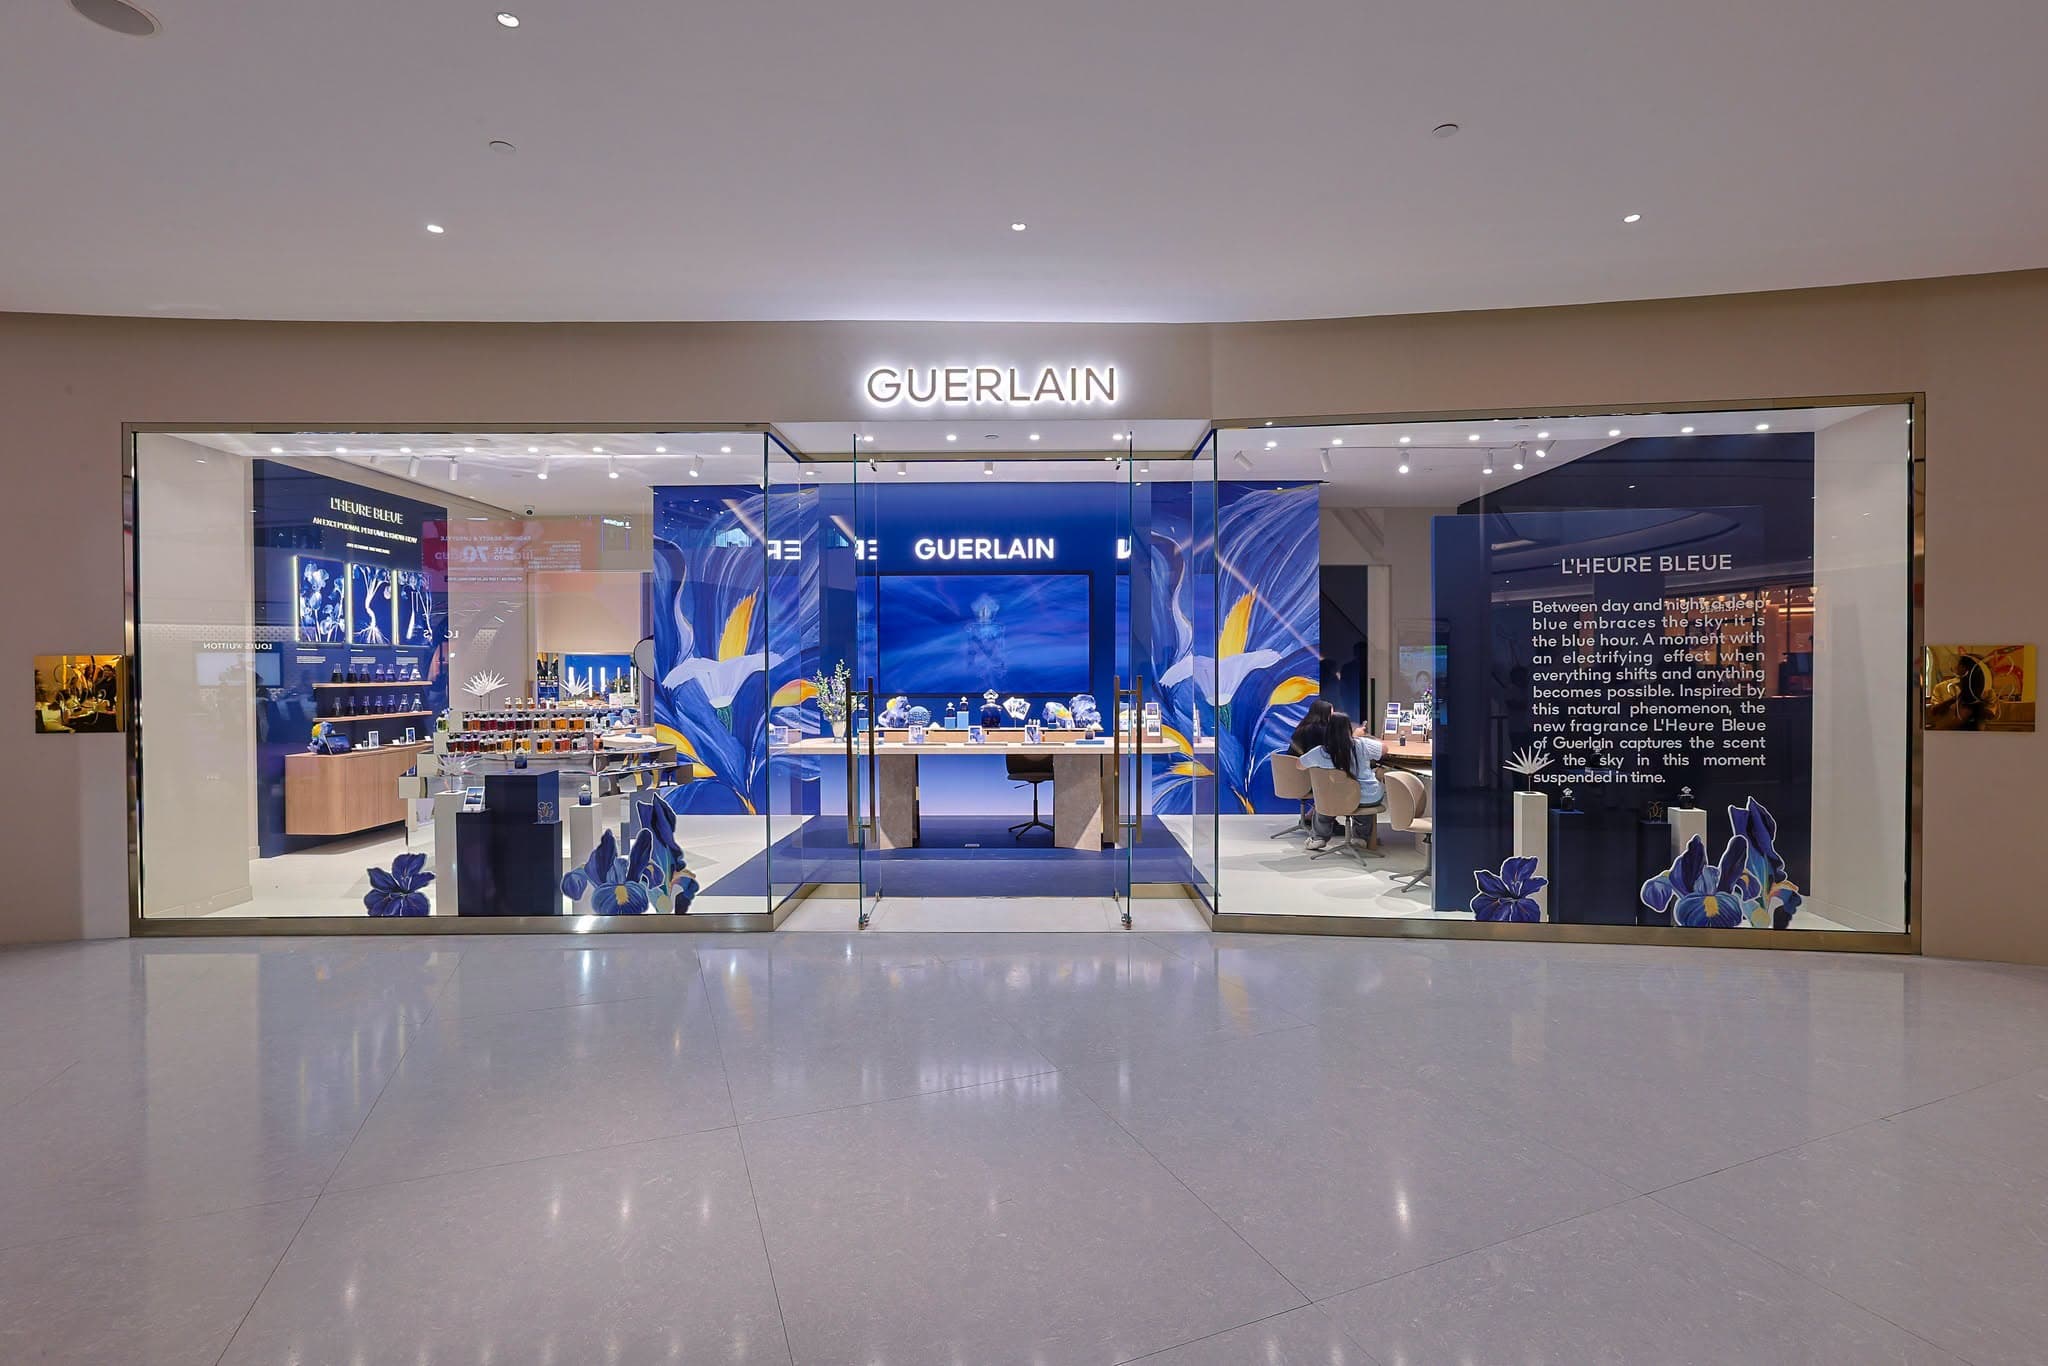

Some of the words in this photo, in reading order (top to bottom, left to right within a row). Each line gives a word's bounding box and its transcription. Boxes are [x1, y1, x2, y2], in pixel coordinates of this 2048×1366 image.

[867, 368, 1115, 402] GUERLAIN
[330, 497, 373, 518] L'HEURE
[373, 506, 404, 525] BLEUE
[915, 538, 1055, 560] GUERLAIN
[1561, 556, 1652, 574] L'HEURE
[1660, 554, 1733, 573] BLEUE
[1533, 600, 1598, 613] Between
[1602, 599, 1630, 615] day
[1633, 598, 1662, 612] and
[1725, 597, 1765, 612] deep
[1533, 618, 1568, 630] blue
[1573, 616, 1656, 630] embraces
[1661, 615, 1689, 628] the
[1734, 614, 1746, 626] it
[1752, 613, 1765, 626] is
[1532, 634, 1557, 647] the
[1562, 634, 1595, 647] blue
[1600, 633, 1639, 646] hour.
[1642, 633, 1655, 646] A
[1660, 634, 1725, 646] moment
[1729, 631, 1765, 644] with
[1533, 655, 1552, 664] an
[1562, 651, 1653, 666] electrifying
[1663, 649, 1710, 662] effect
[1720, 649, 1765, 661] when
[1533, 668, 1611, 684] everything
[1616, 667, 1657, 680] shifts
[1662, 666, 1692, 680] and
[1696, 666, 1765, 682] anything
[1533, 686, 1601, 698] becomes
[1607, 684, 1675, 700] possible.
[1680, 683, 1741, 700] Inspired
[1747, 683, 1765, 699] by
[1532, 702, 1559, 715] this
[1567, 702, 1620, 715] natural
[1630, 702, 1732, 718] phenomenon,
[1740, 701, 1766, 714] the
[1533, 723, 1565, 732] new
[1570, 720, 1648, 735] fragrance
[1653, 719, 1714, 731] L'Heure
[1722, 718, 1766, 731] Bleue
[1533, 736, 1547, 749] of
[1553, 736, 1614, 749] Guerlain
[1619, 737, 1682, 752] captures
[1689, 736, 1715, 749] the
[1722, 737, 1766, 749] scent
[1563, 753, 1586, 766] the
[1599, 753, 1624, 769] sky
[1637, 753, 1650, 766] in
[1662, 753, 1689, 766] this
[1703, 754, 1766, 766] moment
[1533, 770, 1612, 786] suspended
[1616, 770, 1628, 783] in
[1631, 771, 1666, 783] time.
